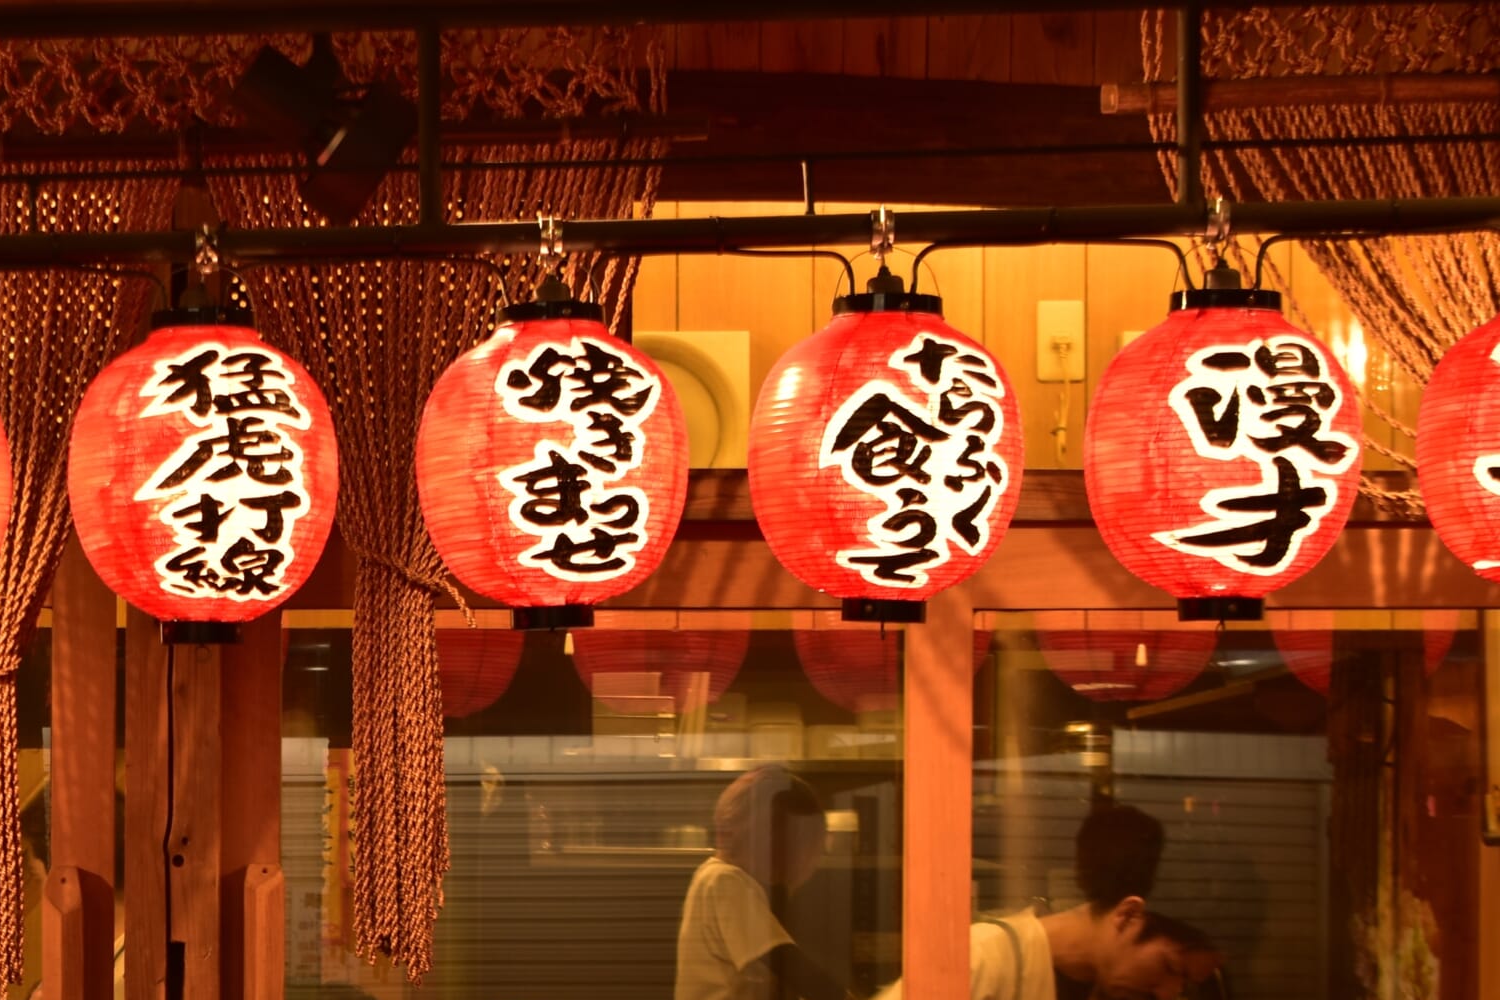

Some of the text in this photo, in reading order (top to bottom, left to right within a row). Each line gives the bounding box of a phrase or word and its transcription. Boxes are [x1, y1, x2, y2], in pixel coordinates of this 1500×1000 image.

[156, 350, 302, 596] 猛虎打線
[506, 341, 655, 573] 焼きまっせ
[831, 393, 951, 583] 食うて
[903, 338, 1003, 548] たらふく
[1177, 341, 1348, 567] 漫才
